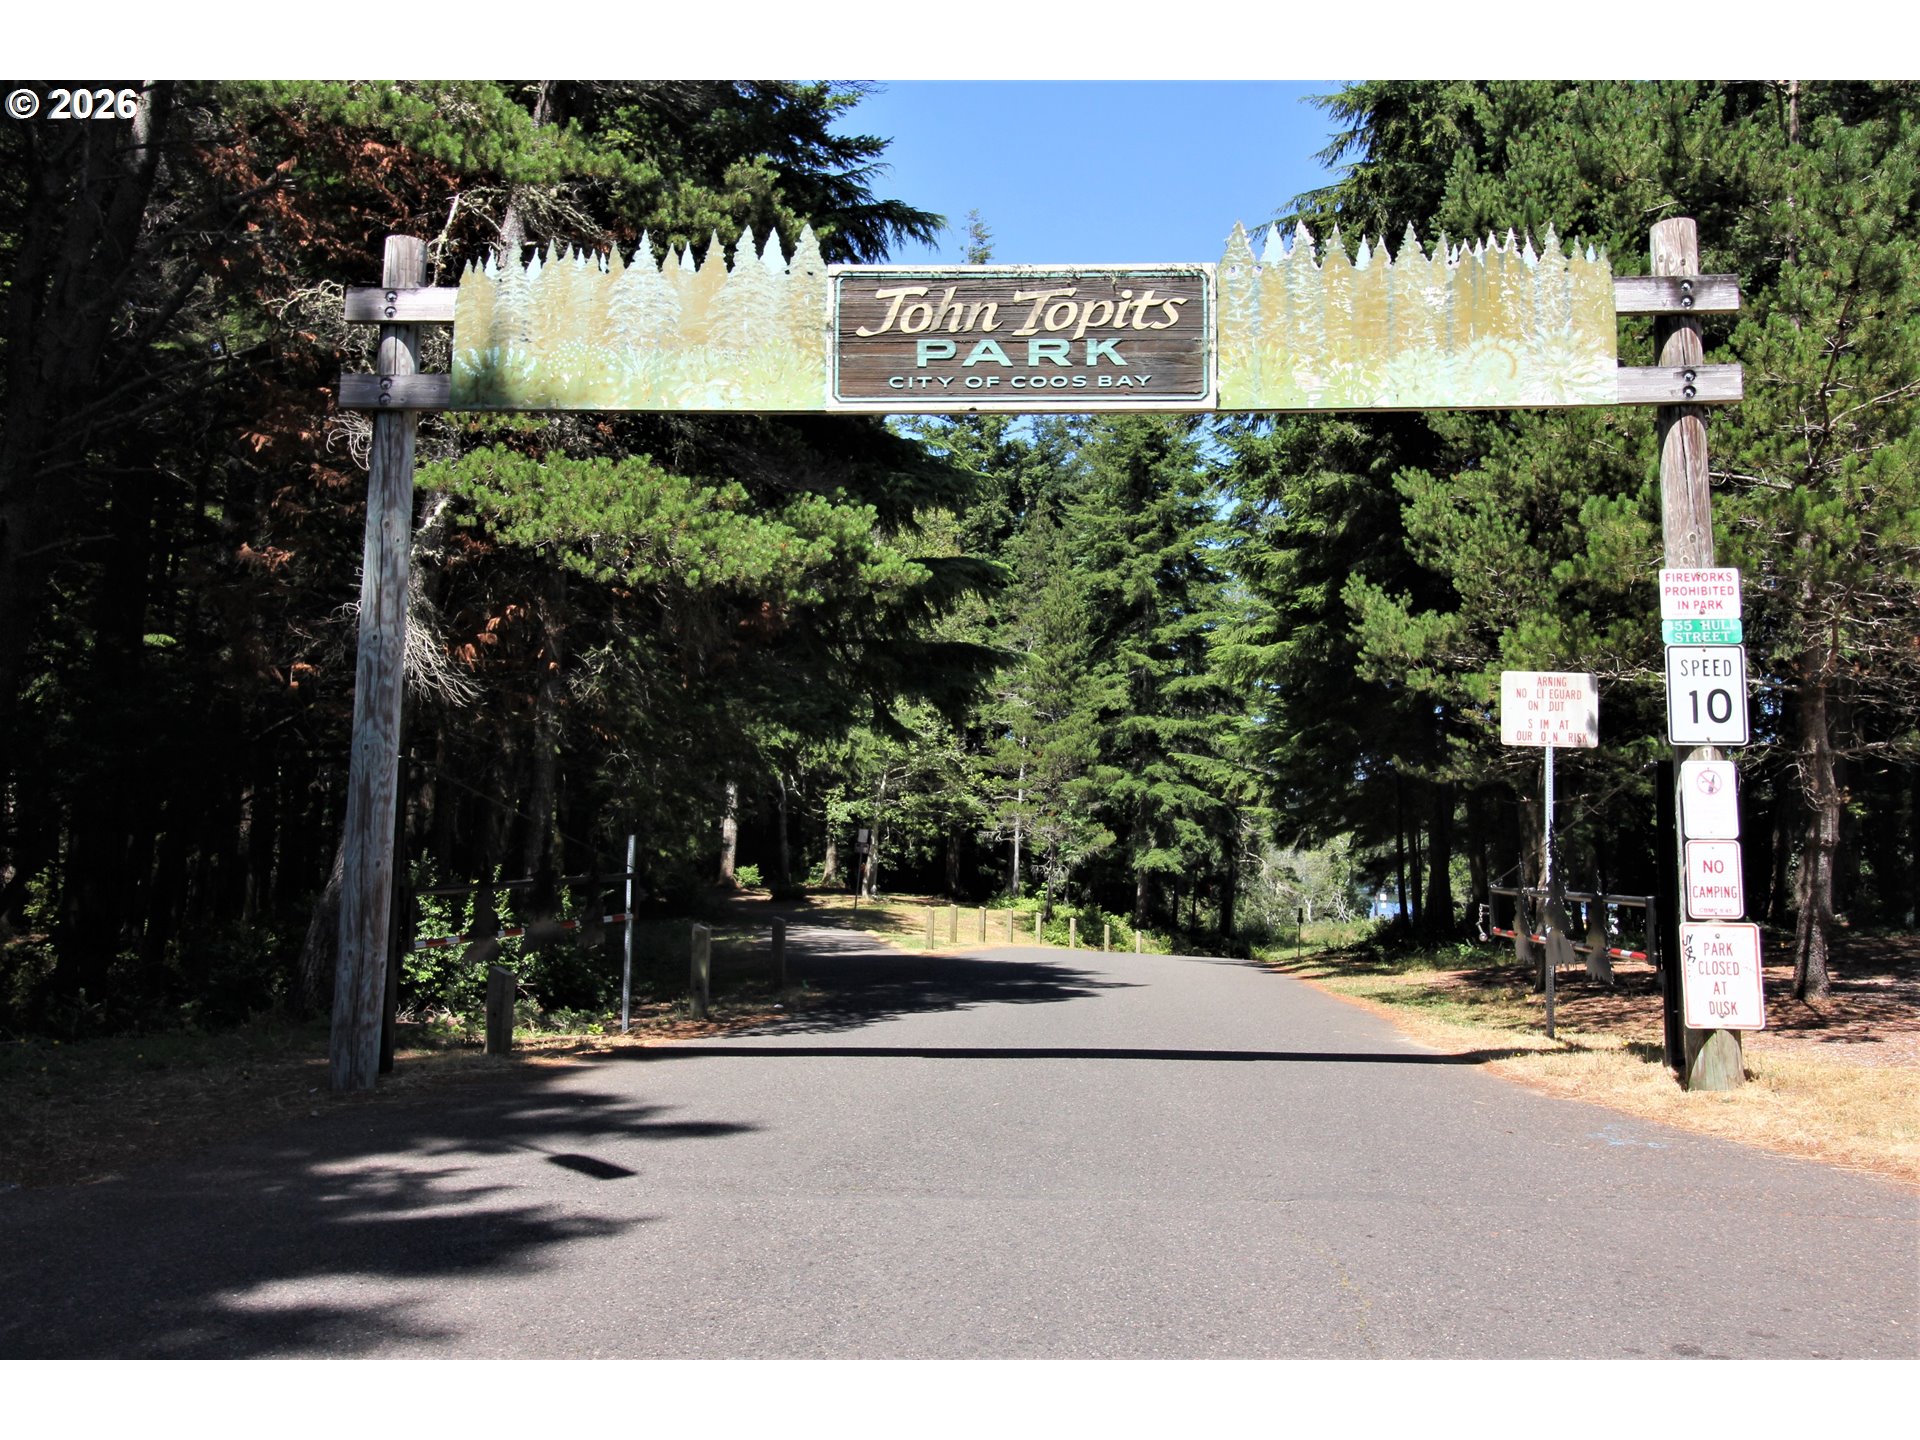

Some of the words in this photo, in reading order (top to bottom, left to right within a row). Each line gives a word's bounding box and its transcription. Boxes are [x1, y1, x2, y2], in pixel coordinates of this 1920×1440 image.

[855, 286, 1004, 338] John
[1011, 287, 1189, 342] Topits
[916, 338, 1129, 368] PARK
[888, 376, 955, 389] CITY
[965, 376, 1001, 389] OF
[1010, 375, 1088, 389] COOS
[1097, 375, 1153, 388] BAY
[1665, 572, 1733, 583] FIREWORKS
[1665, 586, 1735, 596] PROHIBITED
[1677, 600, 1689, 610] IN
[1693, 600, 1723, 610] PARK
[1671, 620, 1693, 632] 55
[1702, 620, 1738, 631] HULL
[1674, 631, 1731, 643] STREET
[1680, 659, 1732, 677] SPEED
[1536, 676, 1568, 687] ARNING
[1516, 688, 1527, 699] NO
[1536, 688, 1582, 700] LIEGUARD
[1528, 700, 1539, 711] ON
[1548, 701, 1565, 712] DUT
[1689, 688, 1732, 724] 10
[1528, 718, 1550, 730] SIM
[1559, 719, 1569, 730] AT
[1516, 730, 1533, 741] OUR
[1540, 731, 1558, 742] ON
[1568, 732, 1588, 743] RISK
[1702, 859, 1724, 874] NO
[1692, 885, 1737, 899] CAMPING
[1703, 942, 1733, 956] PARK
[1698, 961, 1740, 976] CLOSED
[1713, 981, 1727, 995] AT
[1709, 1000, 1738, 1016] DUSK
